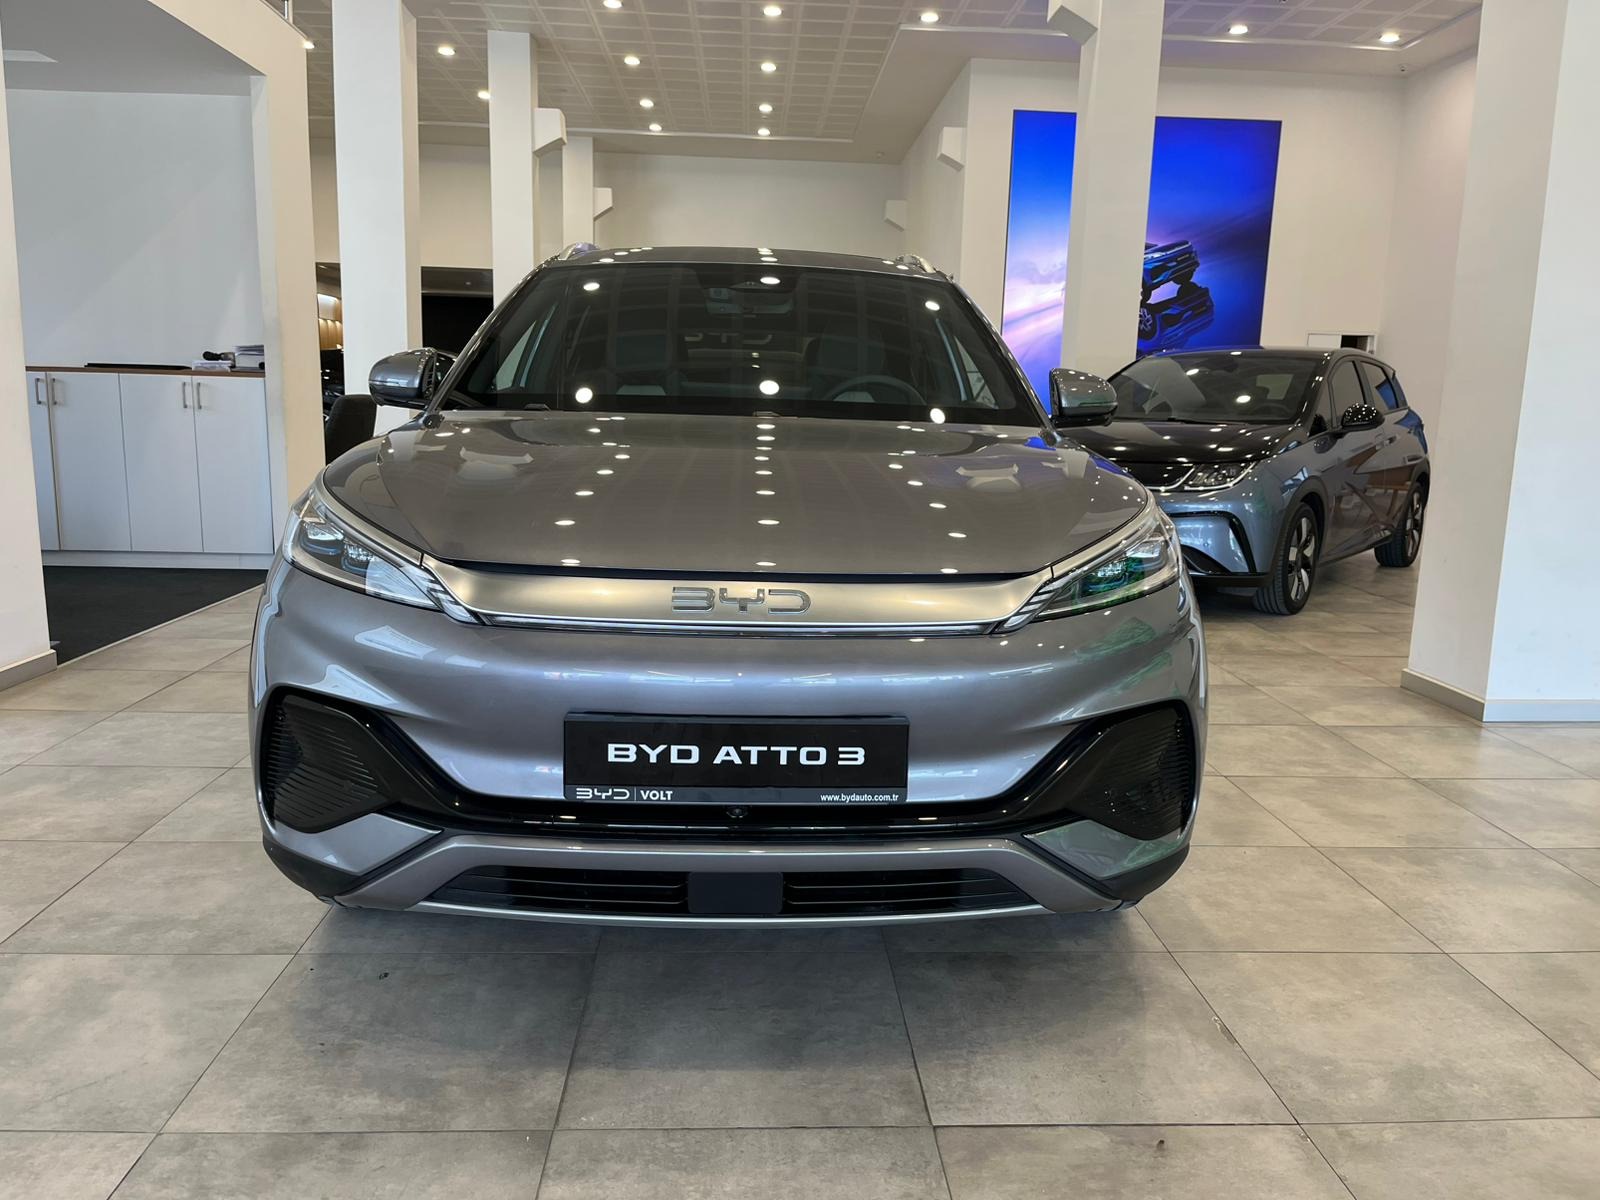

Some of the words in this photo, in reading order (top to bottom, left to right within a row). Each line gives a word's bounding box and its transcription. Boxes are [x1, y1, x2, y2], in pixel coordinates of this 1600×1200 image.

[672, 586, 812, 614] BYD
[607, 743, 700, 764] BYD
[712, 745, 827, 766] ATTO
[837, 746, 866, 766] 3
[576, 787, 630, 800] BYD
[640, 790, 674, 801] VOLT
[820, 792, 899, 804] www.bydauto.com.tr
